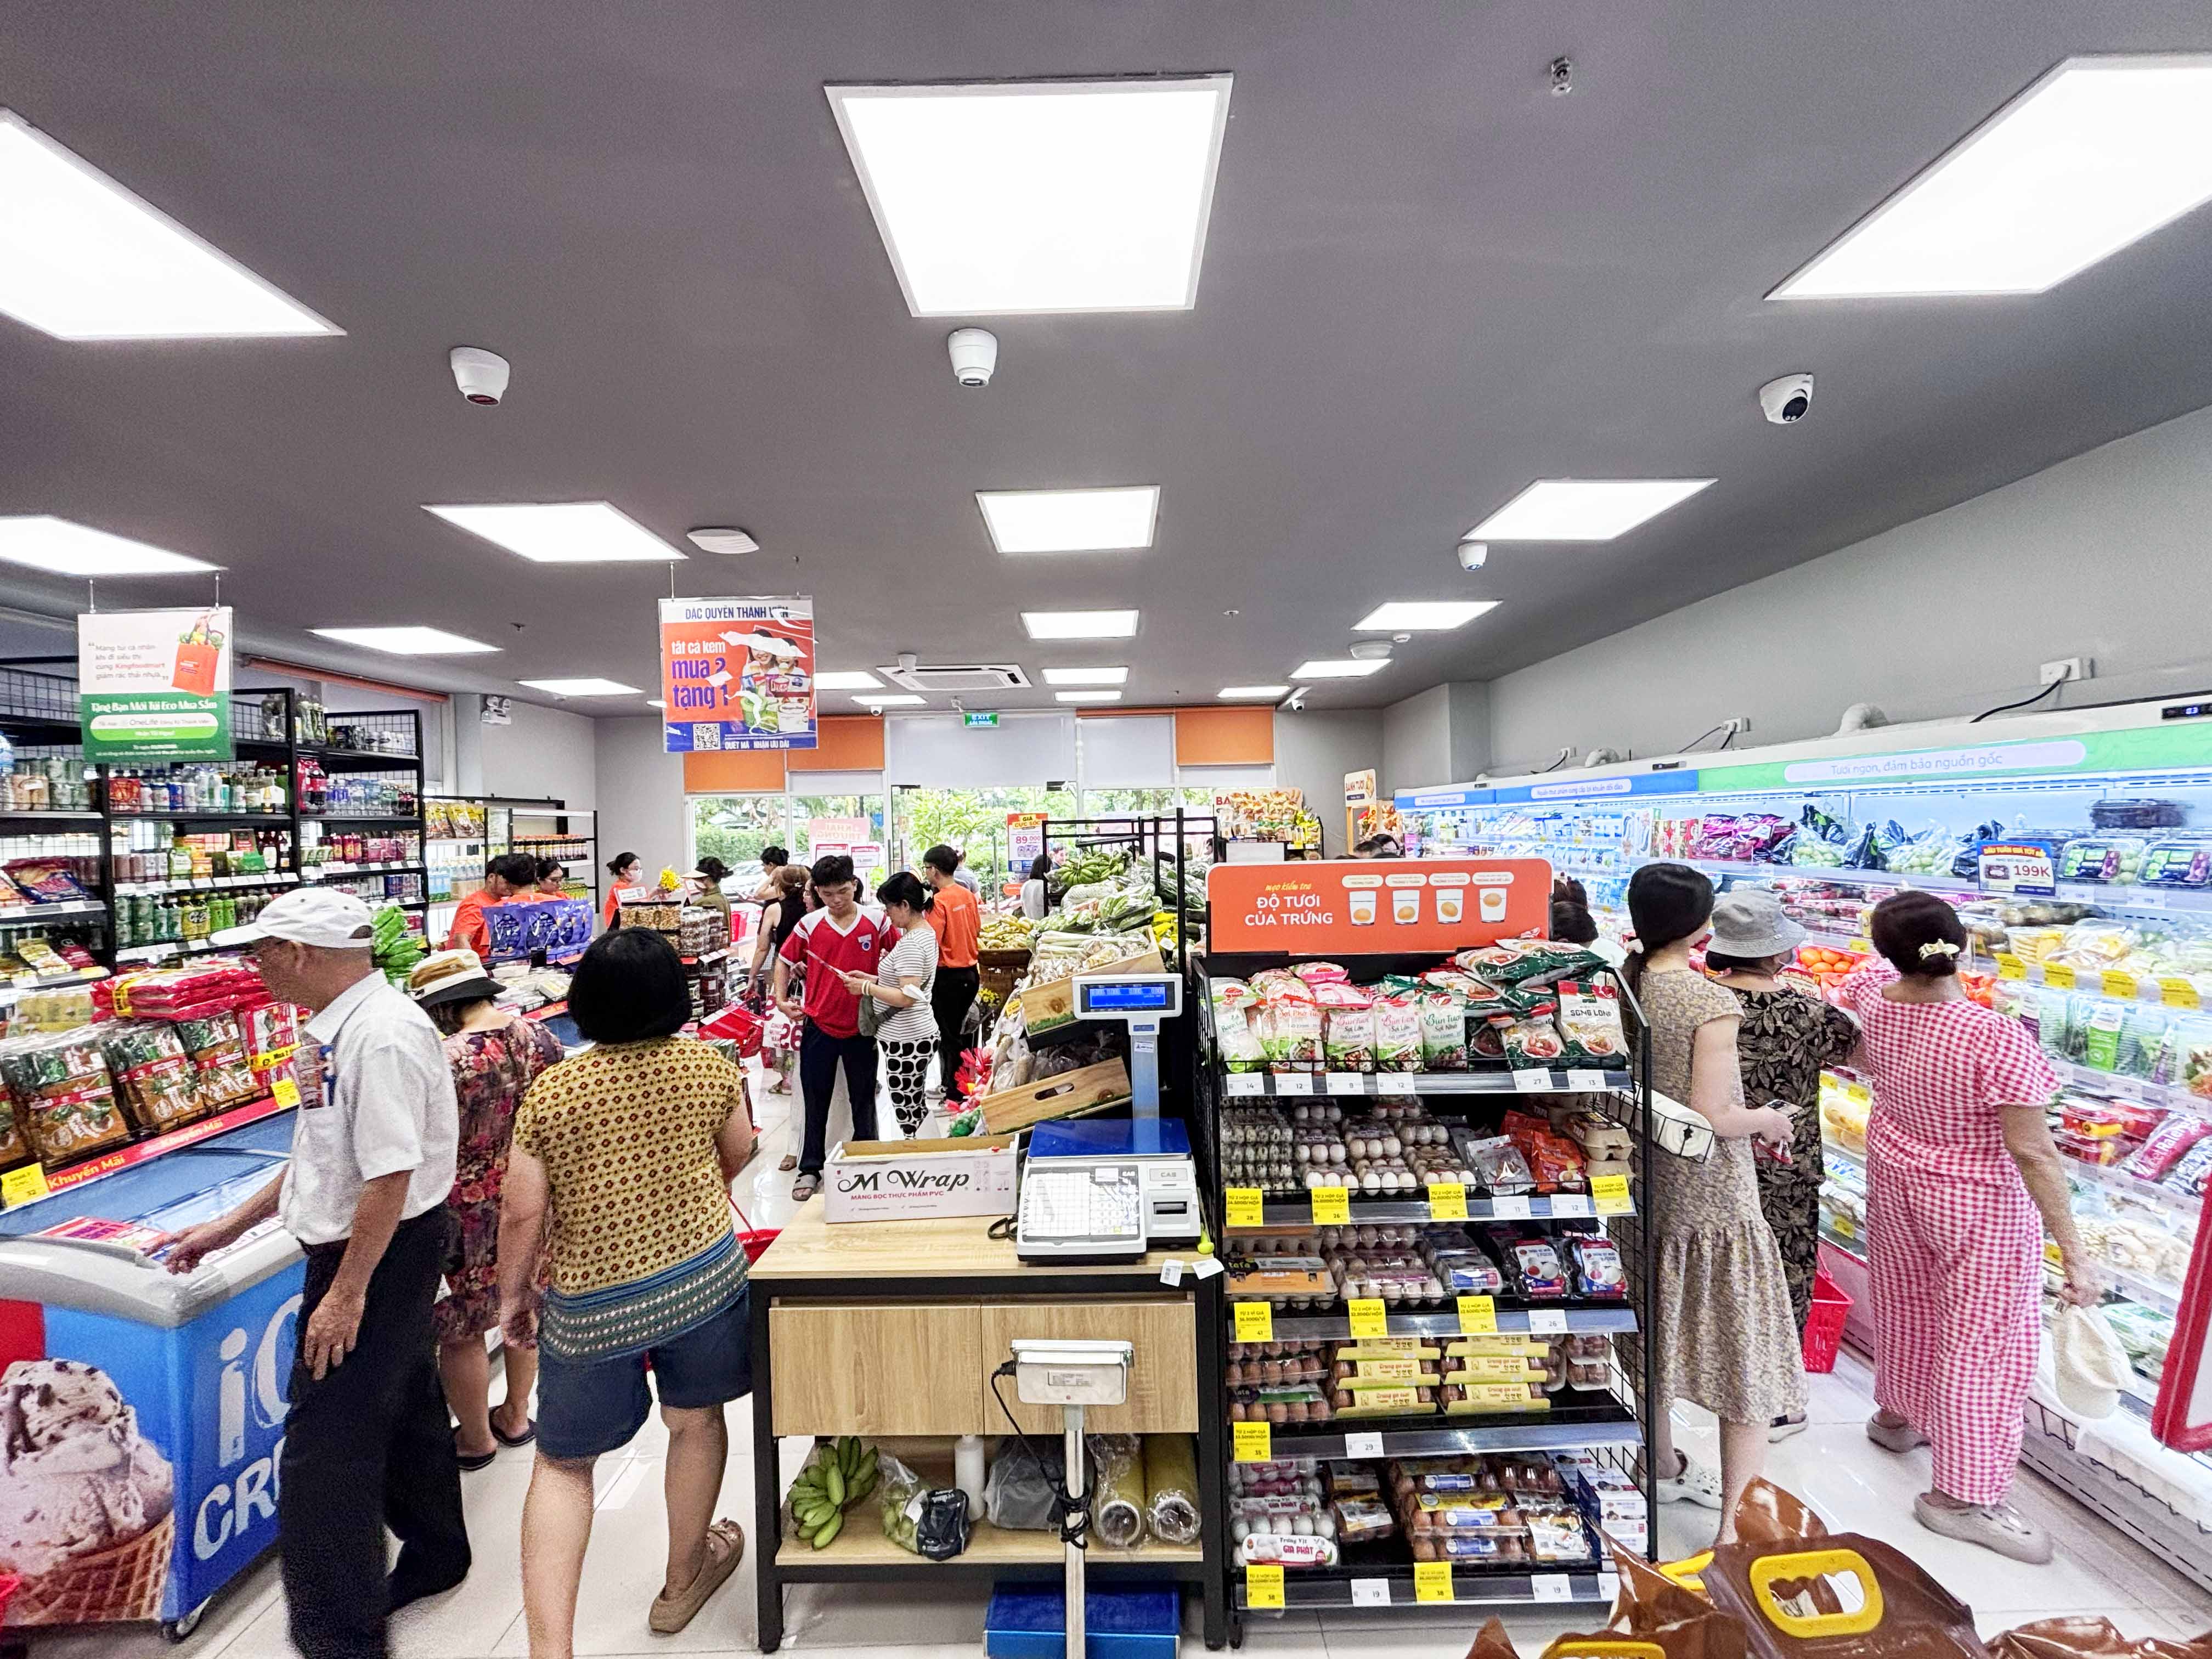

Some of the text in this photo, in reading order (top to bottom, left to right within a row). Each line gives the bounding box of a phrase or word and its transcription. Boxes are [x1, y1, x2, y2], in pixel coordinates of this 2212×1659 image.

[687, 640, 701, 654] cả
[702, 640, 726, 653] kem
[672, 657, 726, 679] mua 2
[673, 684, 715, 710] tặng
[161, 702, 177, 710] Eco
[2013, 865, 2051, 877] 199K
[1256, 893, 1321, 911] ĐỘ TƯƠI
[1245, 910, 1333, 926] CỦA TRỨNG
[1570, 1009, 1593, 1017] SONG
[201, 1119, 224, 1133] Mãi
[47, 1165, 100, 1190] Khuyến
[101, 1155, 126, 1171] Mãi
[838, 1170, 969, 1193] M Wrap
[1283, 1545, 1314, 1555] GIA PHÁT
